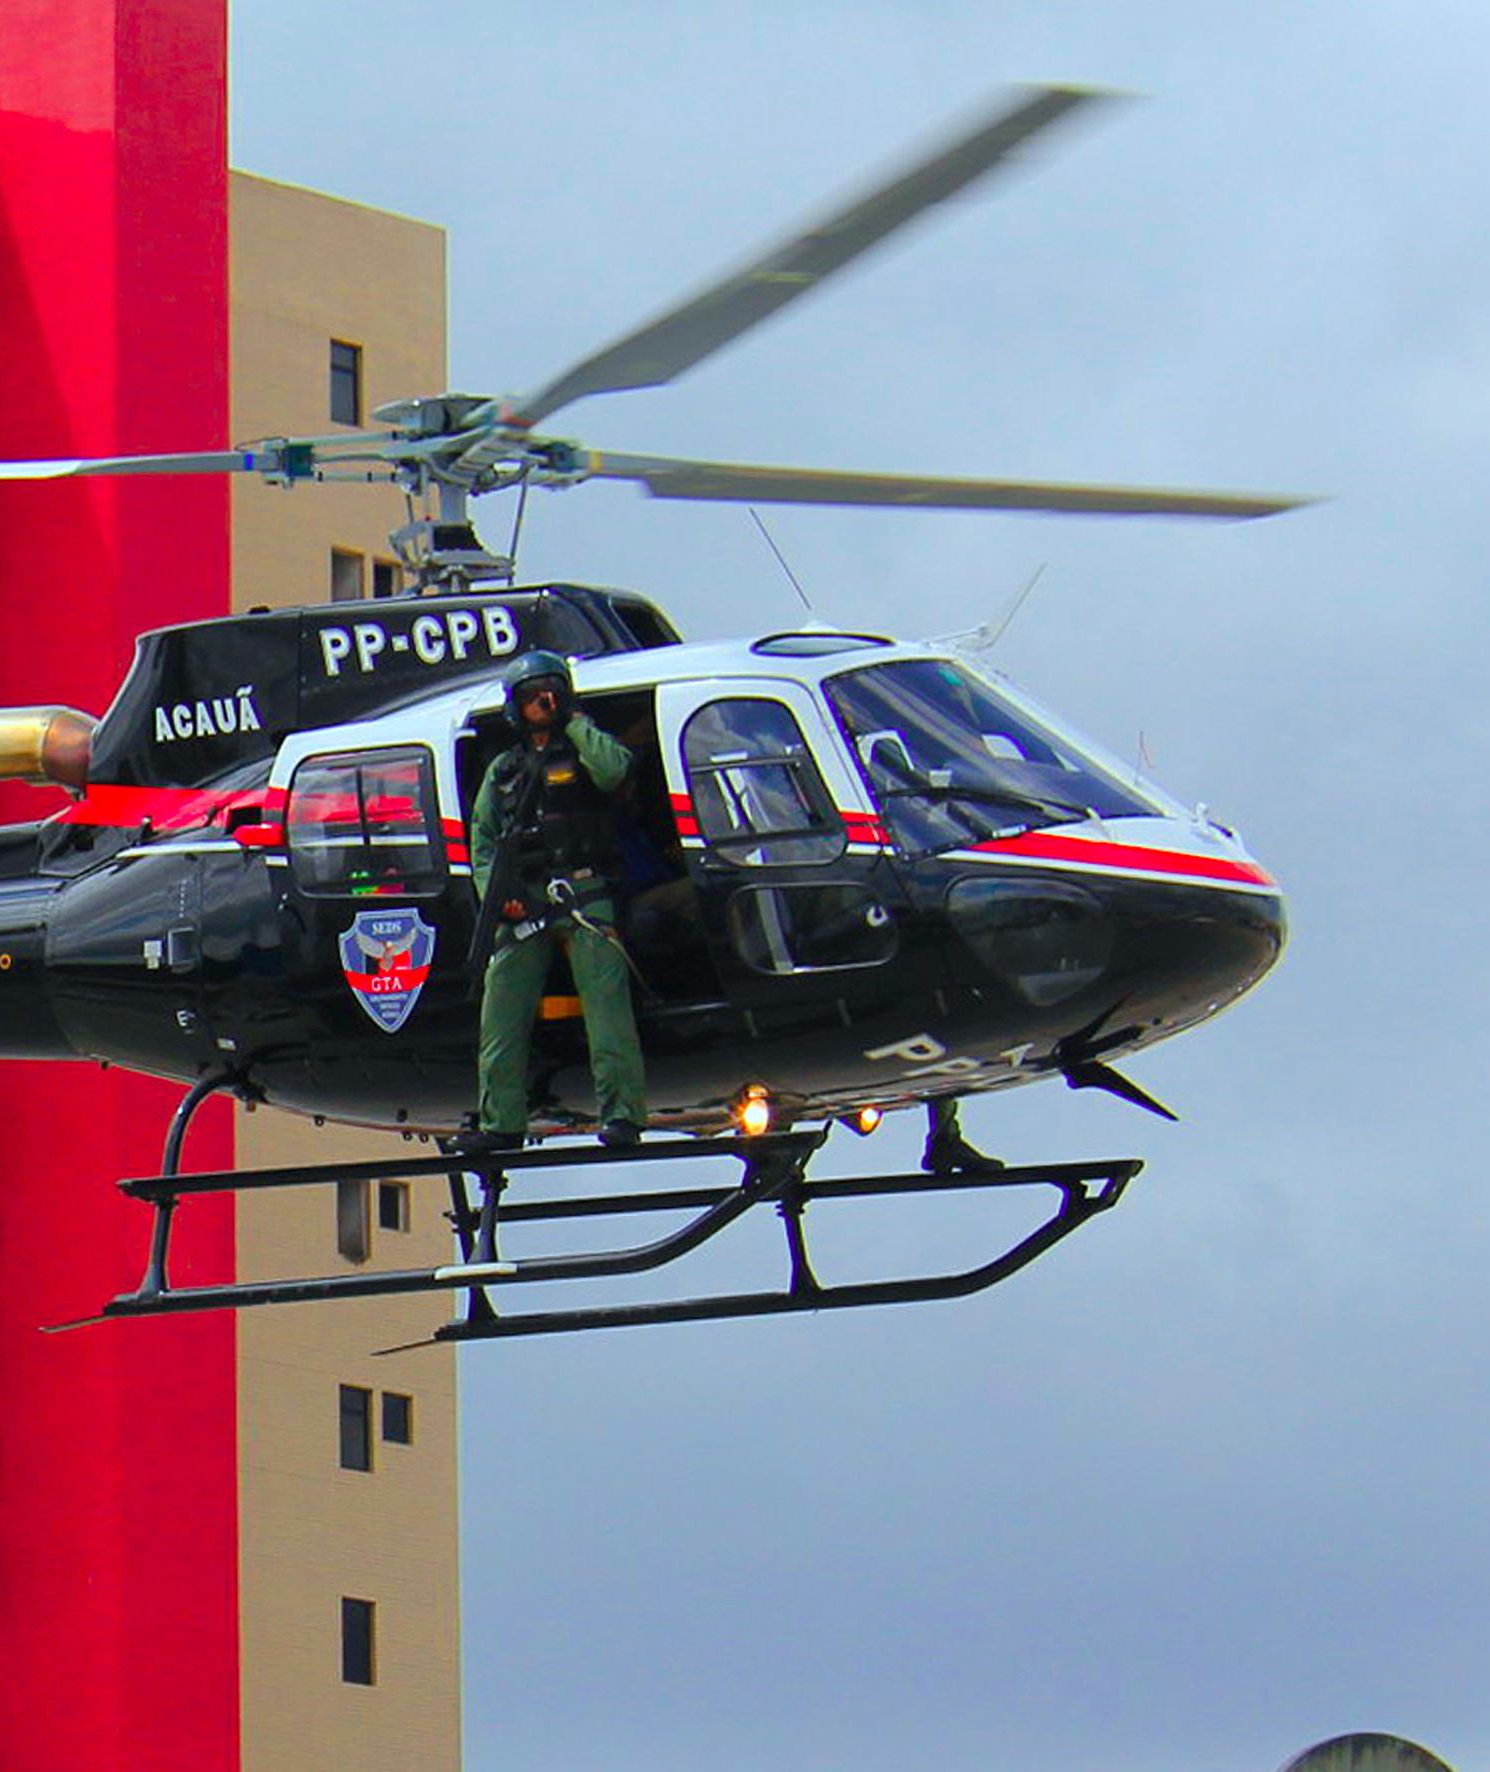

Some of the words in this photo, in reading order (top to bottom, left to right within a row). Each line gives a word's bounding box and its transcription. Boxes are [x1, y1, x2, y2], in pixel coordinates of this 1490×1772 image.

[318, 605, 519, 677] PP-CPB
[154, 685, 261, 743] ACAUÃ
[371, 976, 403, 992] GTA
